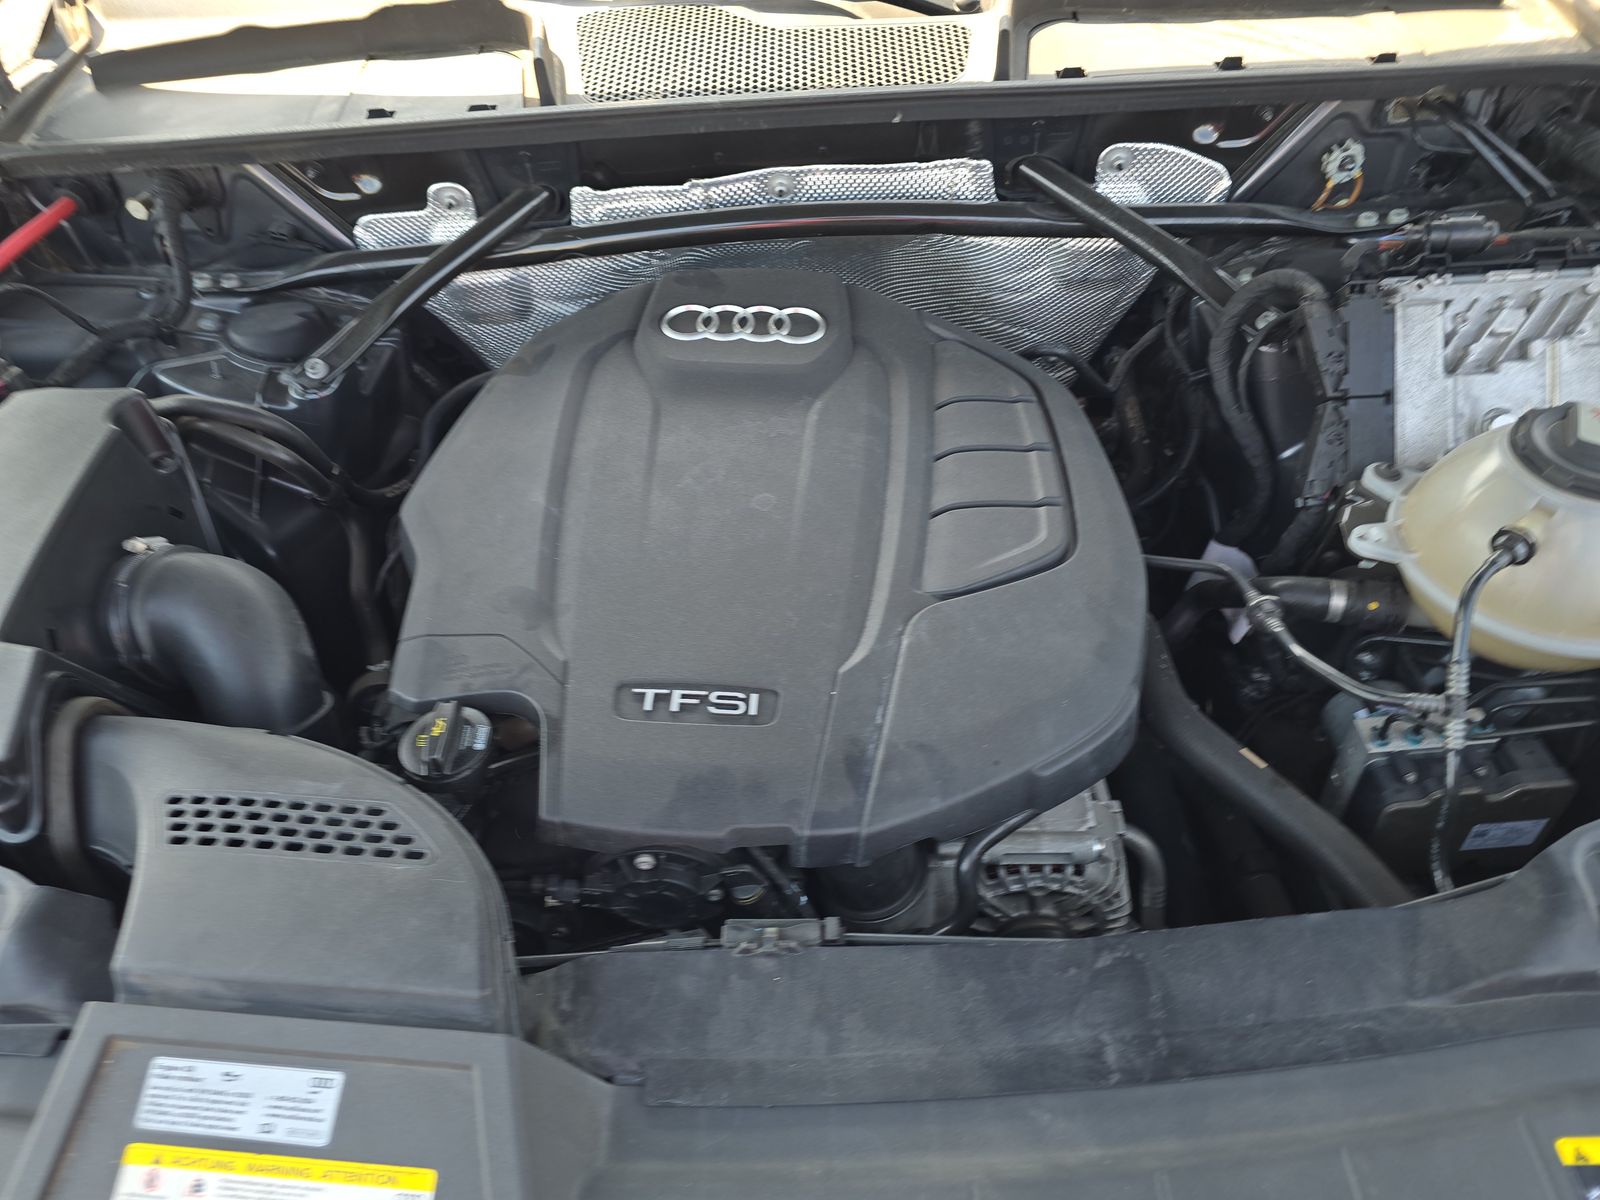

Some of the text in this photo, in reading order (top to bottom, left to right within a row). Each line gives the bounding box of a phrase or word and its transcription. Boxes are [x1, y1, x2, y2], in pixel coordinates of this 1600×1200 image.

[631, 688, 760, 716] TFSI
[170, 1156, 400, 1186] ACHTUNG WARNING ATTENTION
